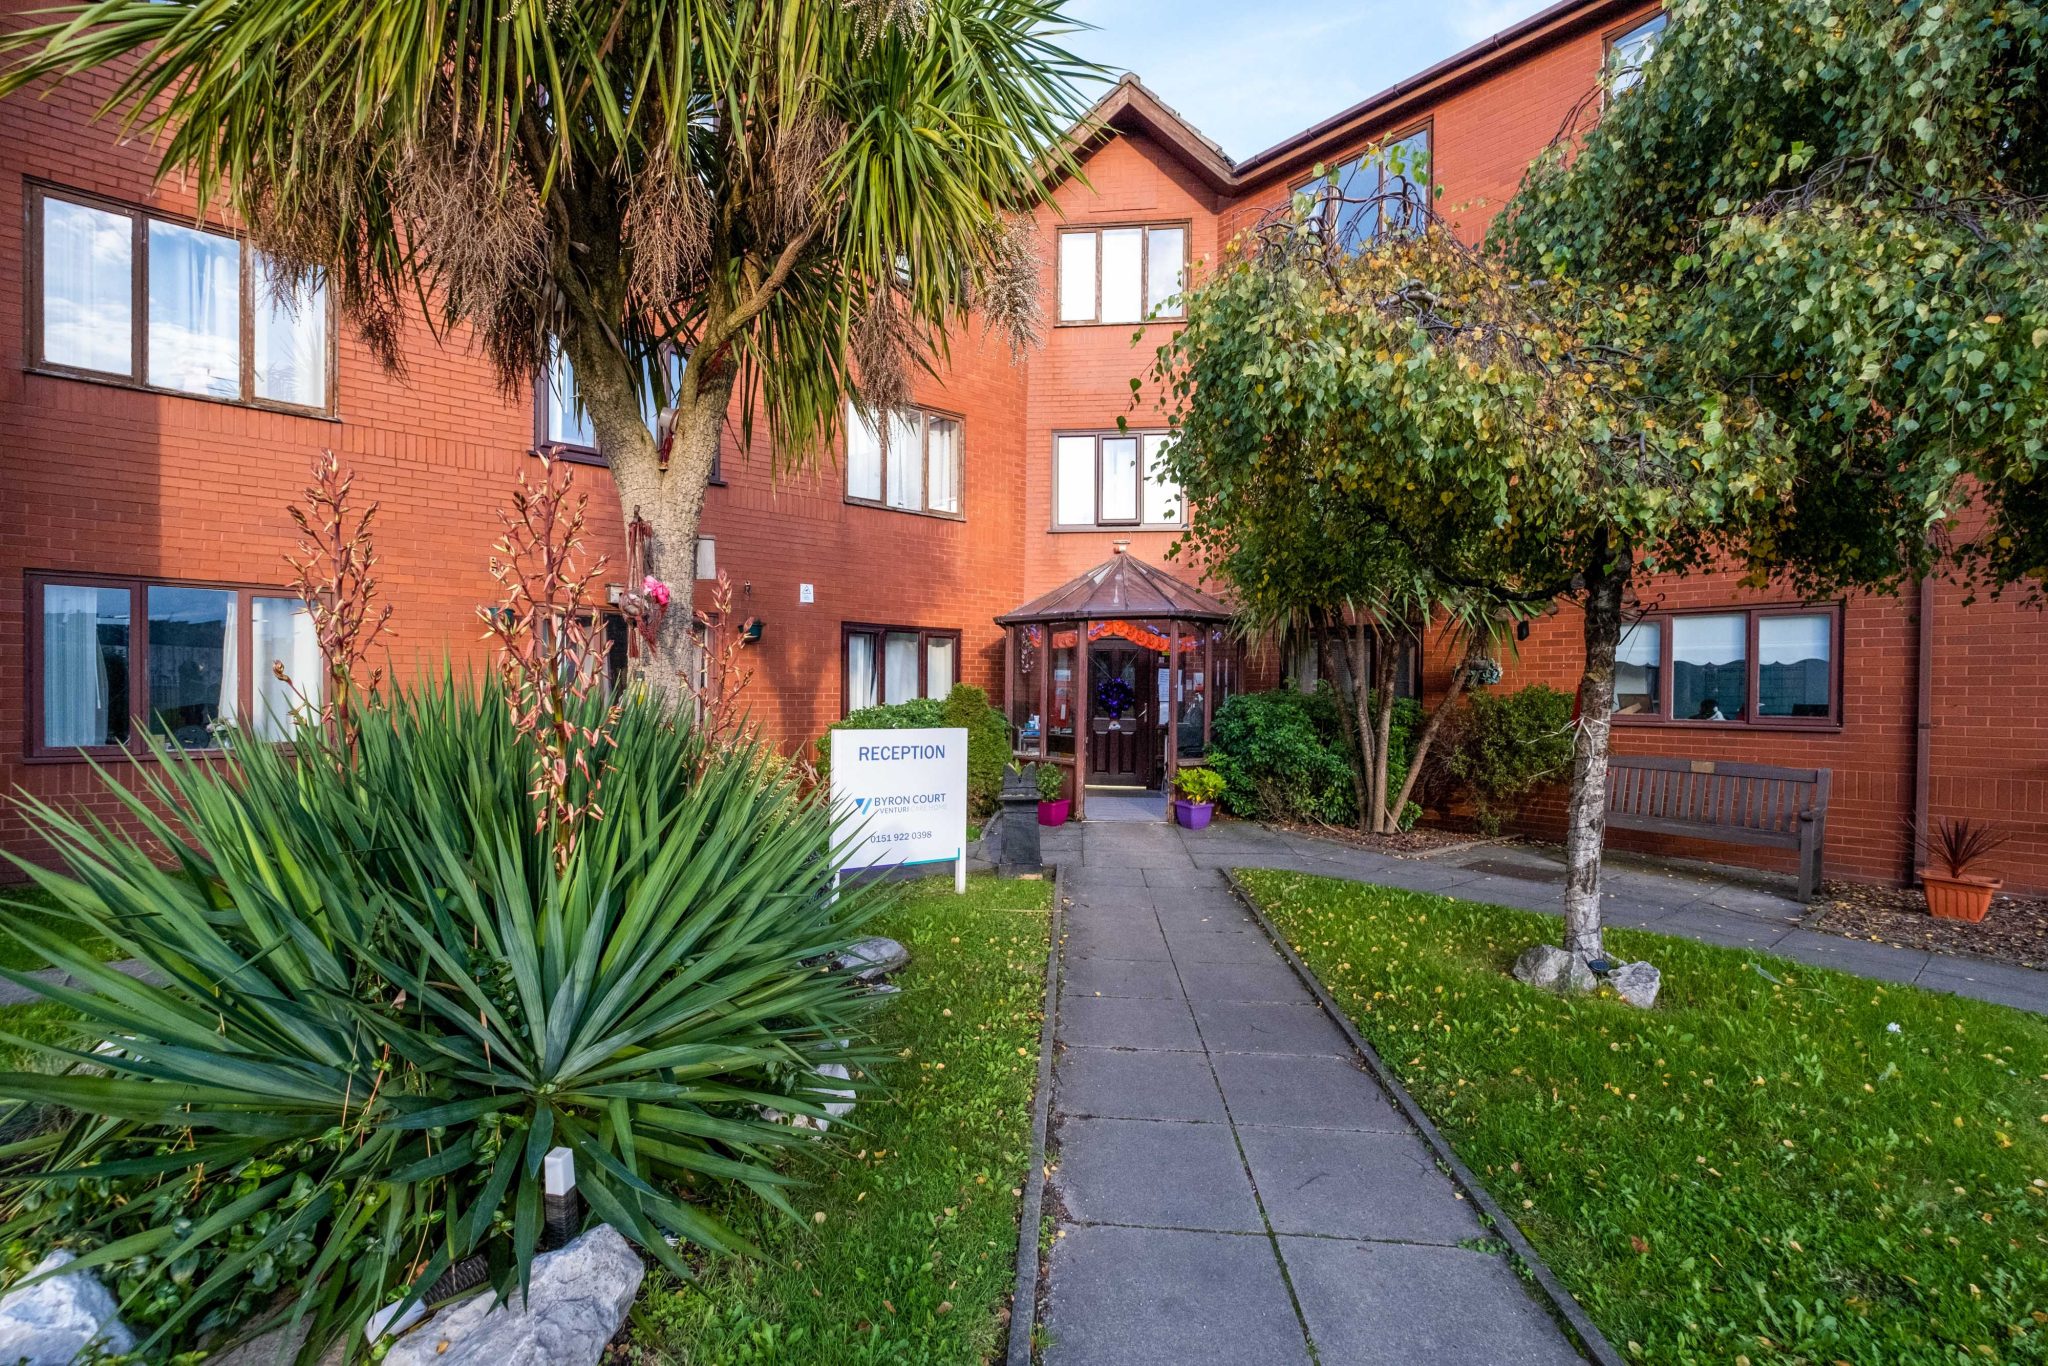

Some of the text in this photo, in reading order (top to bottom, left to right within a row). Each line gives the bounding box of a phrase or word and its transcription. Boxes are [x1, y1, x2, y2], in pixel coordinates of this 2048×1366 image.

[859, 745, 945, 761] RECEPTION
[874, 793, 946, 806] BYRON COURT
[879, 806, 910, 814] VENTURI
[870, 831, 932, 844] 0151 922 0398
